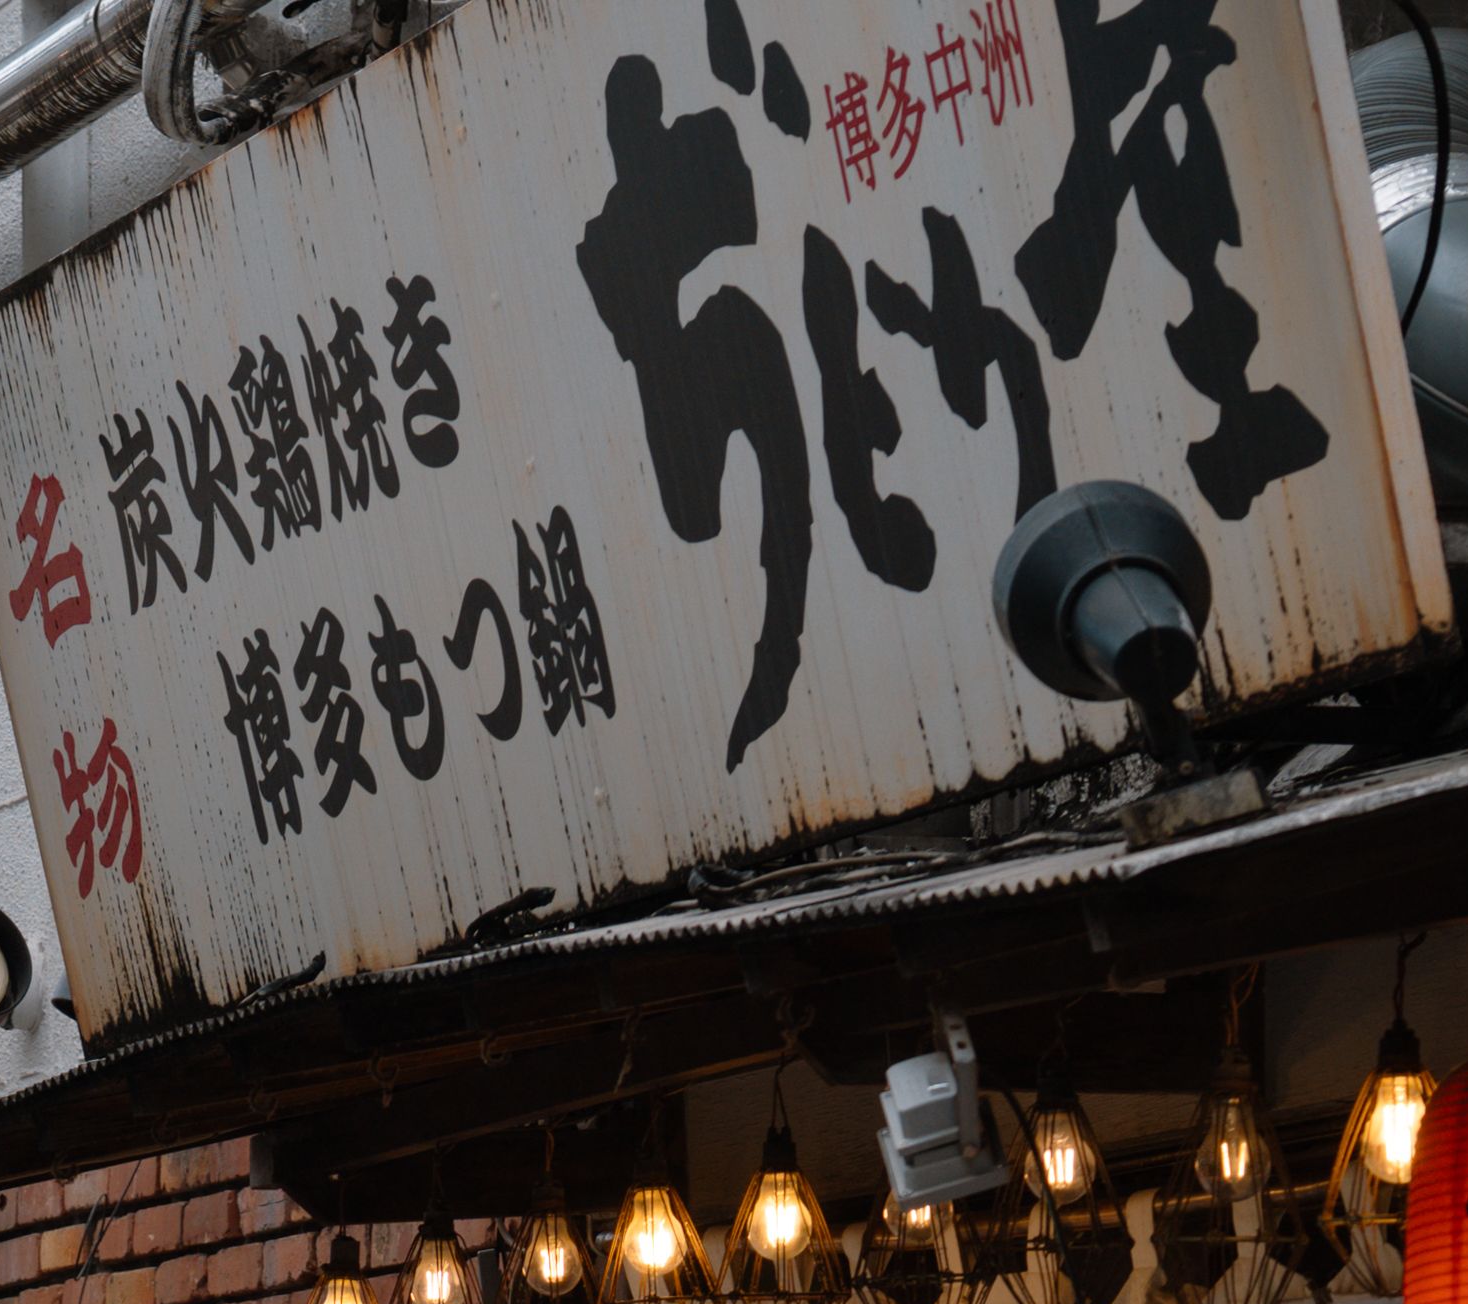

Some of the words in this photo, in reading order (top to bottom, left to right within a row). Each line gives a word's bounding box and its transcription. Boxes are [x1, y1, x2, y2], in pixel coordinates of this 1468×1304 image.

[823, 0, 1034, 204] 博多中洲
[98, 273, 462, 615] 炭火鶏焼き
[9, 472, 145, 899] 名物
[216, 503, 618, 845] 博多もつ鍋
